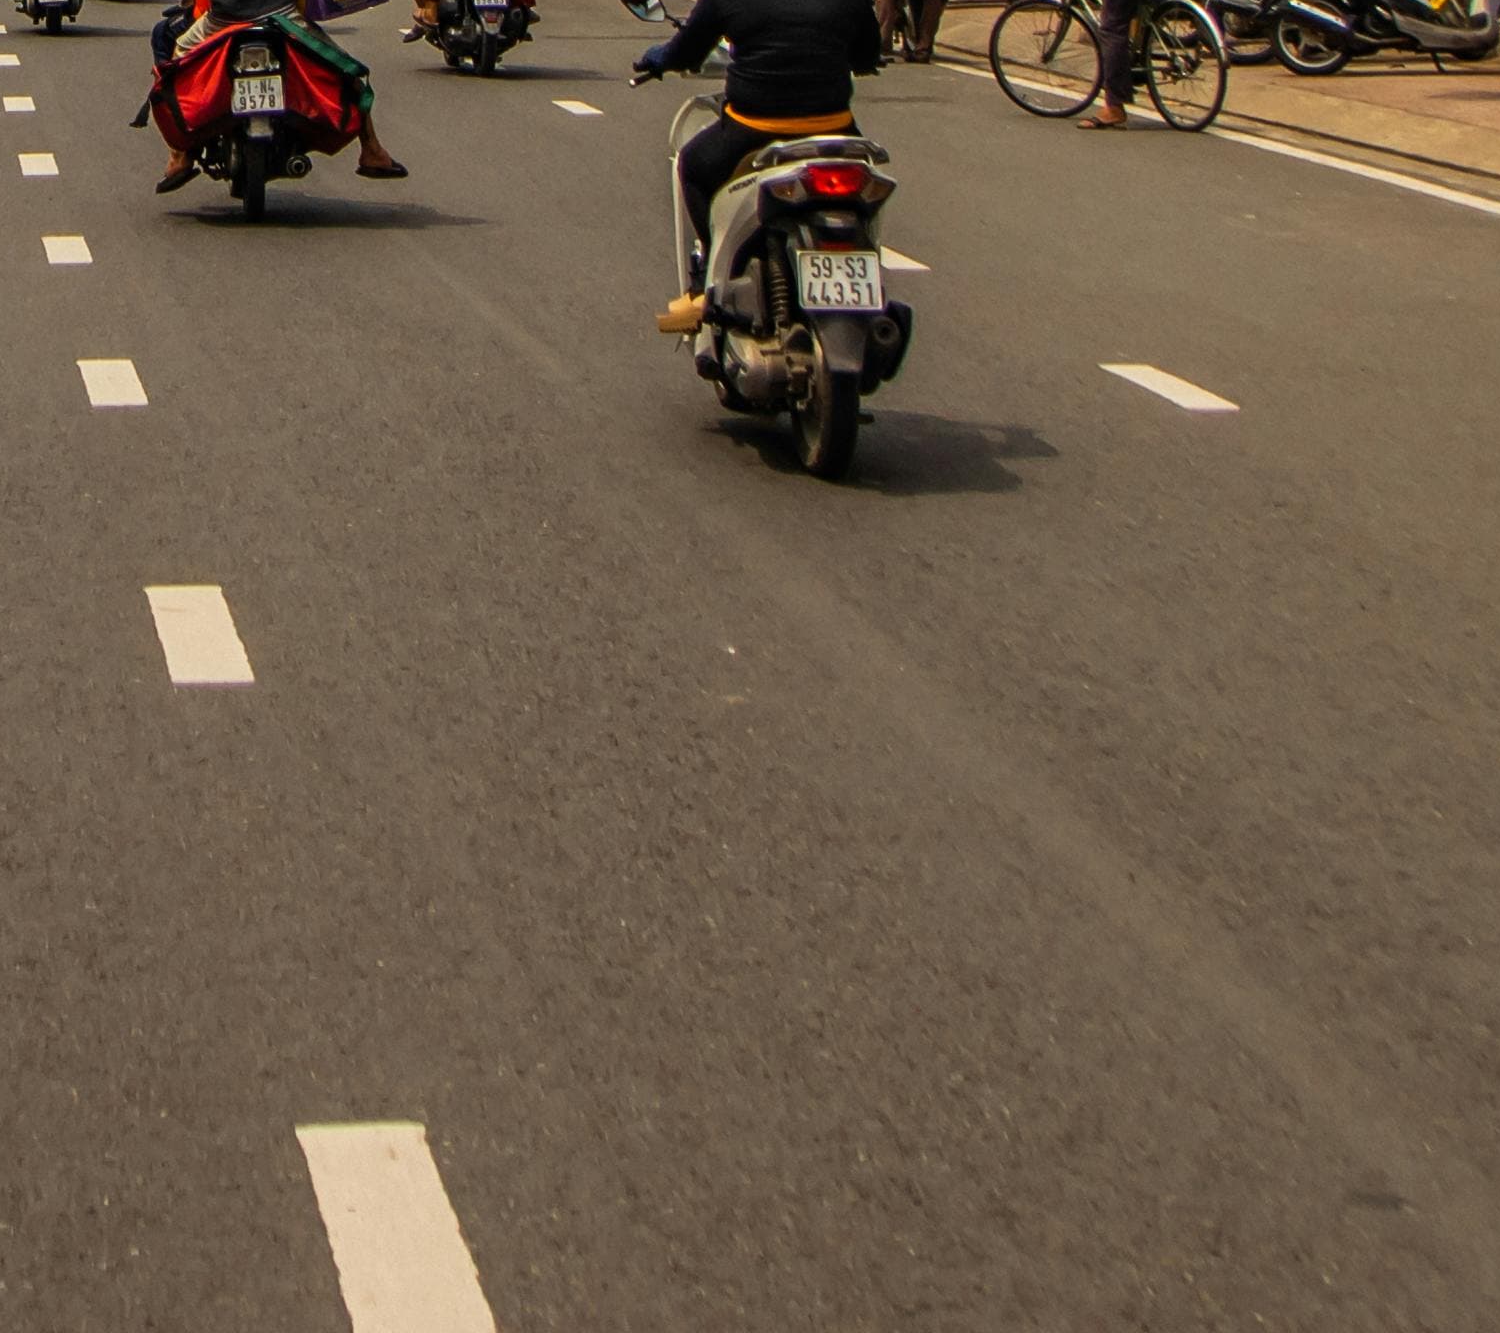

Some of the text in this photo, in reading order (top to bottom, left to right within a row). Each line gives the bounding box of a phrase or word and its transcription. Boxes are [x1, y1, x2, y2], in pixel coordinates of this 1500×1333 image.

[239, 94, 276, 110] 9578
[809, 255, 869, 279] 59-S3
[806, 281, 875, 306] 443.51
